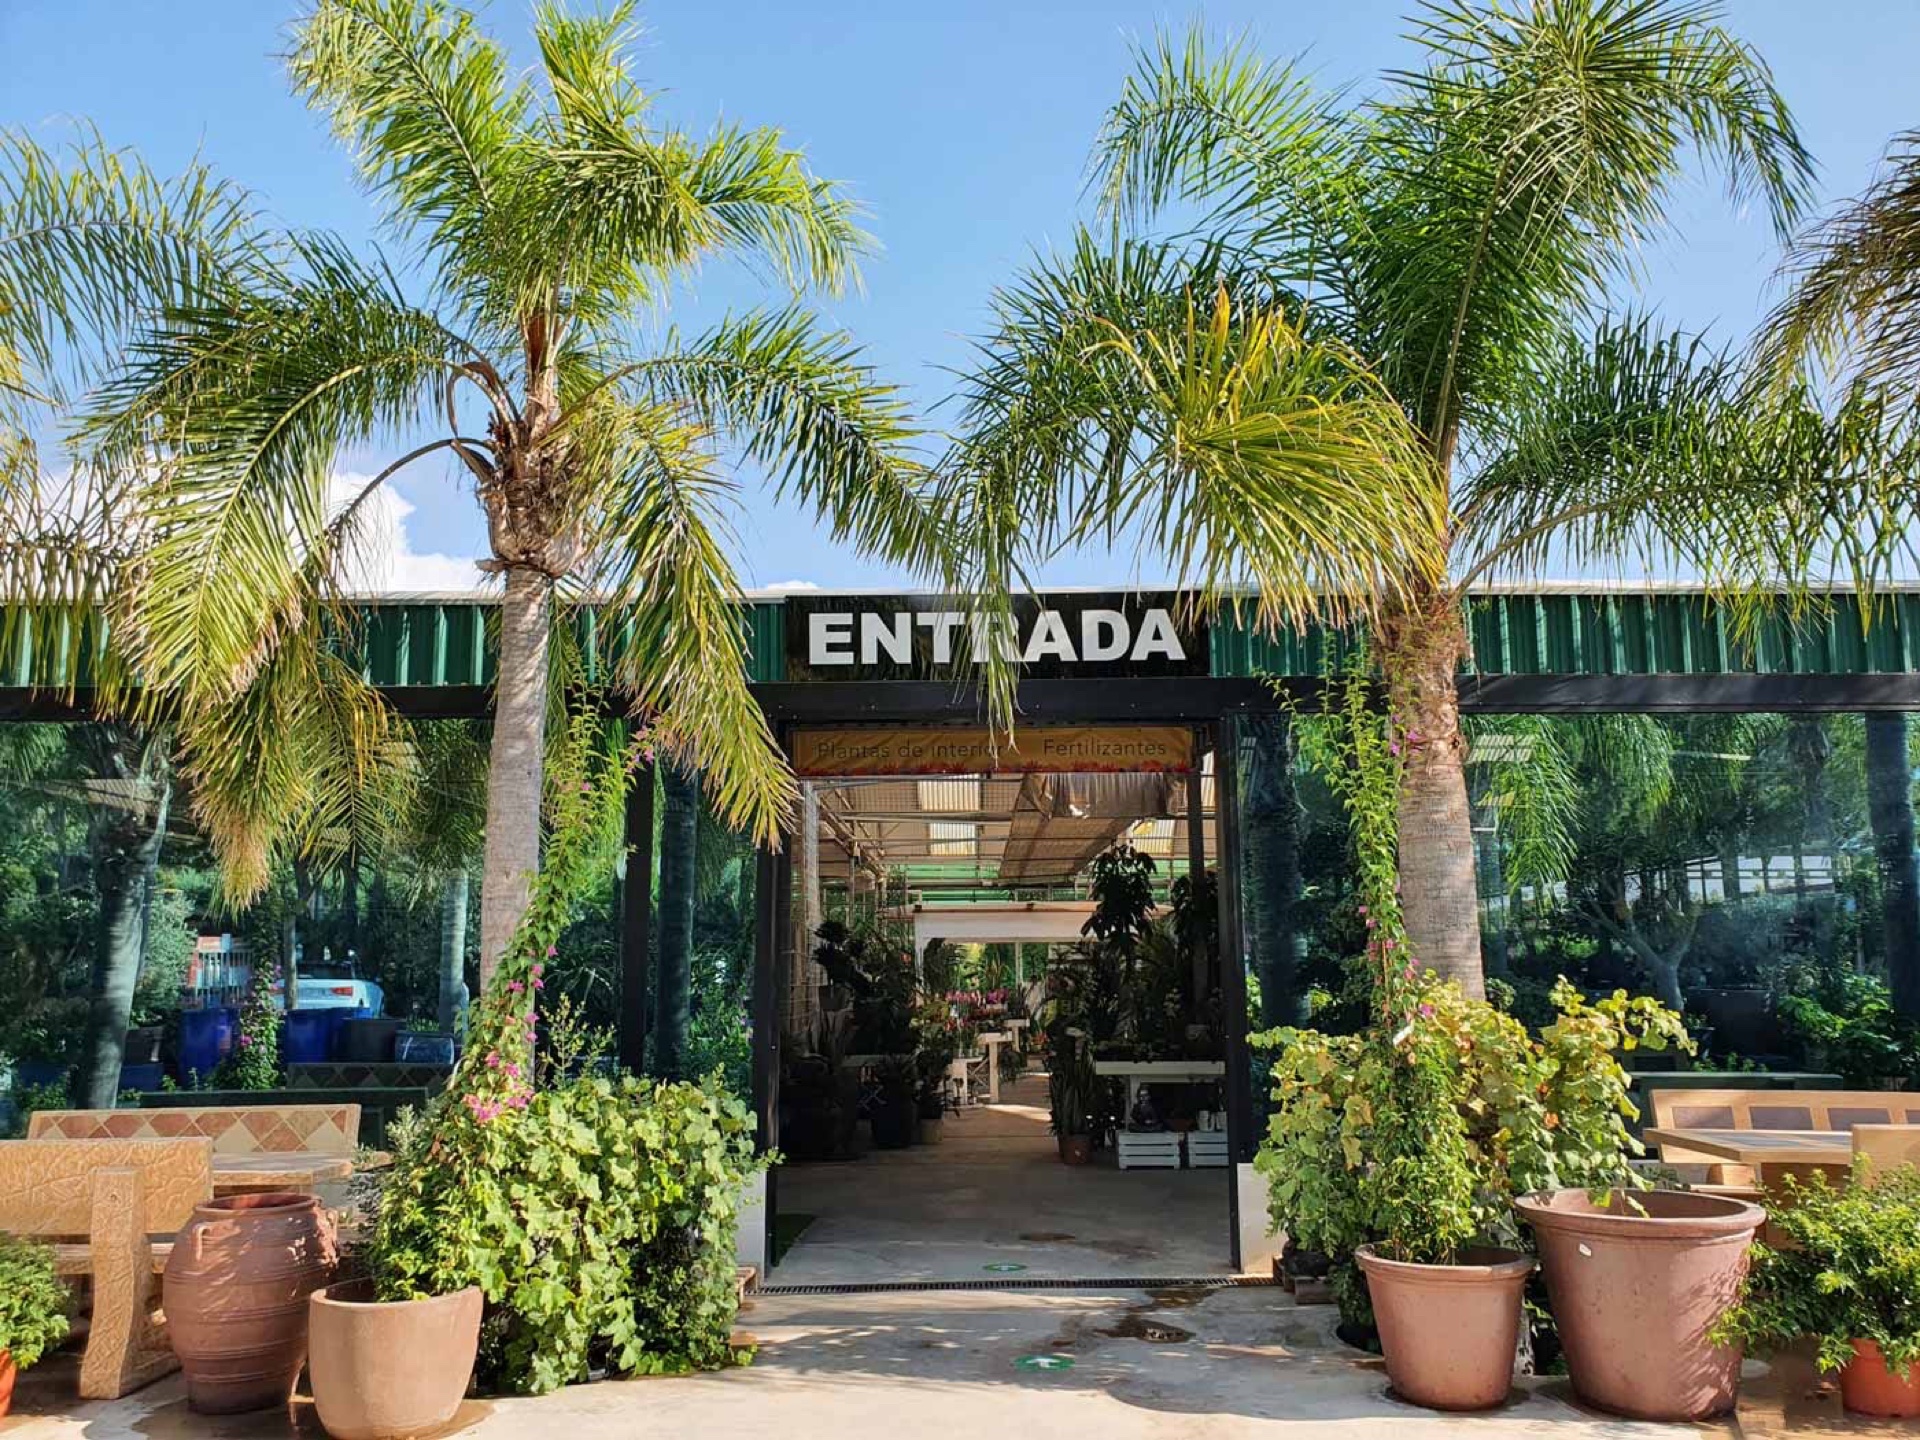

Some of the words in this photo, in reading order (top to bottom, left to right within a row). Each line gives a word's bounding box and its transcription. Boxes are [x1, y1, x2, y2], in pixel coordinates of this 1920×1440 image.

[808, 608, 1187, 665] ENTRADA
[816, 741, 890, 760] Plantas
[897, 739, 924, 758] de
[930, 740, 1005, 758] interior
[1042, 738, 1167, 757] Fertilizantes
